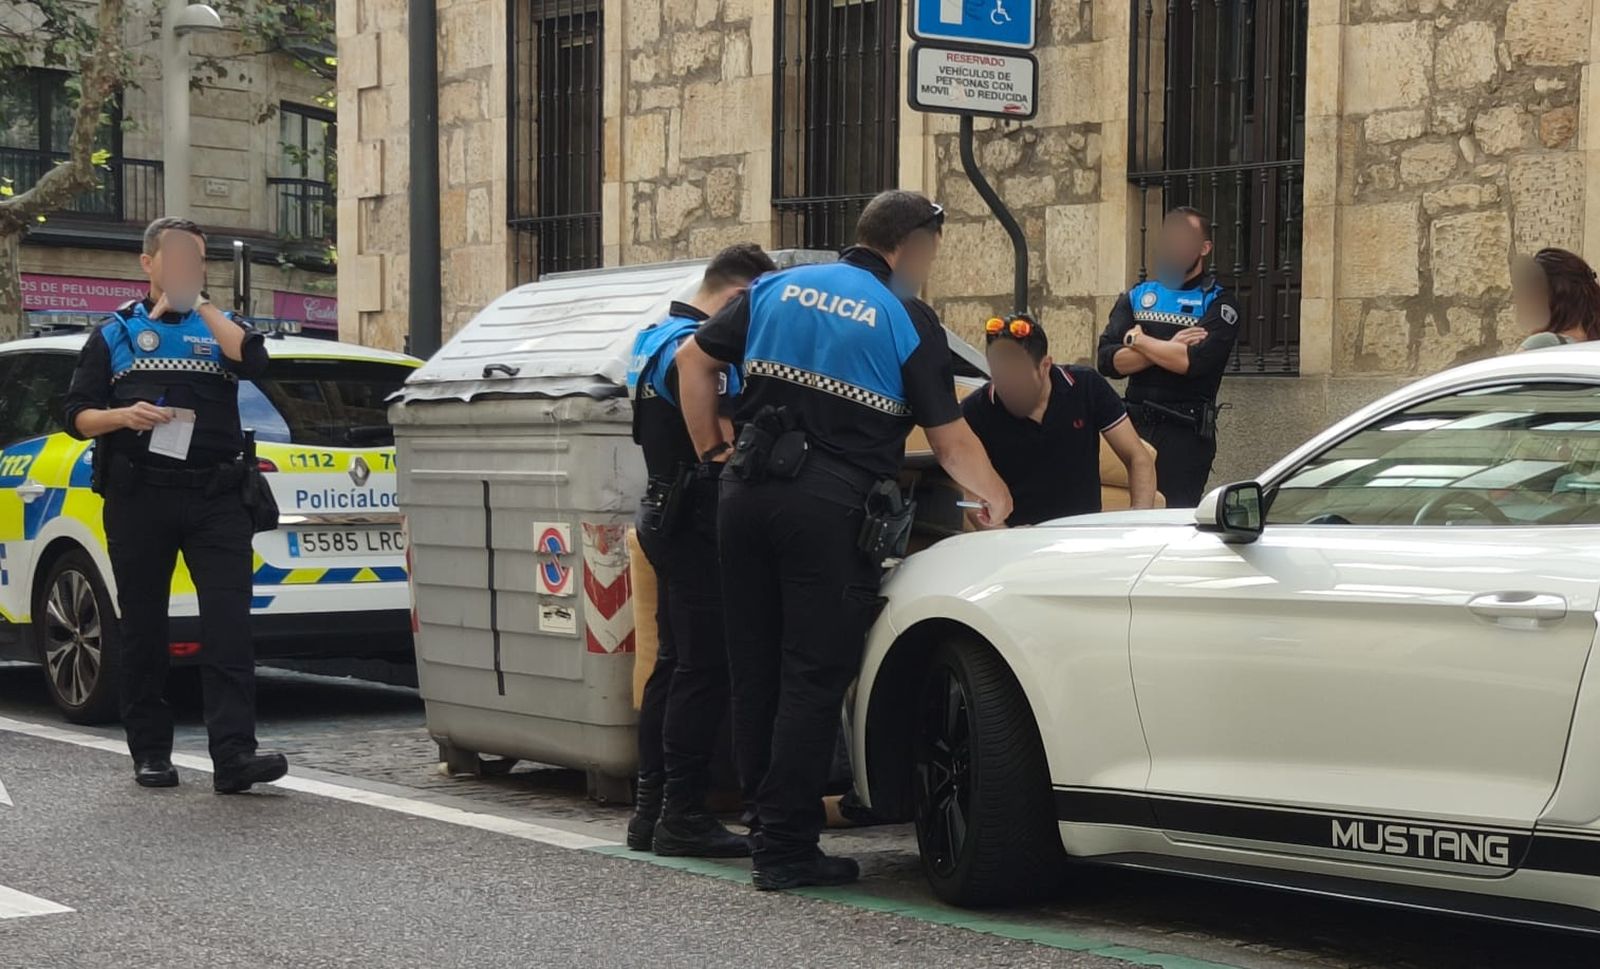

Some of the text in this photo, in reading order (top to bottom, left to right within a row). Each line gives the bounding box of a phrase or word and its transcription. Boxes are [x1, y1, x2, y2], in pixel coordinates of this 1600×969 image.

[946, 52, 1006, 67] RESERVADO
[997, 71, 1011, 81] DE
[991, 81, 1014, 92] CON
[977, 88, 1028, 103] REDUCIDA
[40, 282, 58, 293] DE
[781, 284, 877, 328] POLICÍA
[1, 455, 33, 477] 112
[297, 453, 336, 468] 112
[302, 531, 359, 552] 5585
[1331, 819, 1510, 867] MUSTANG
